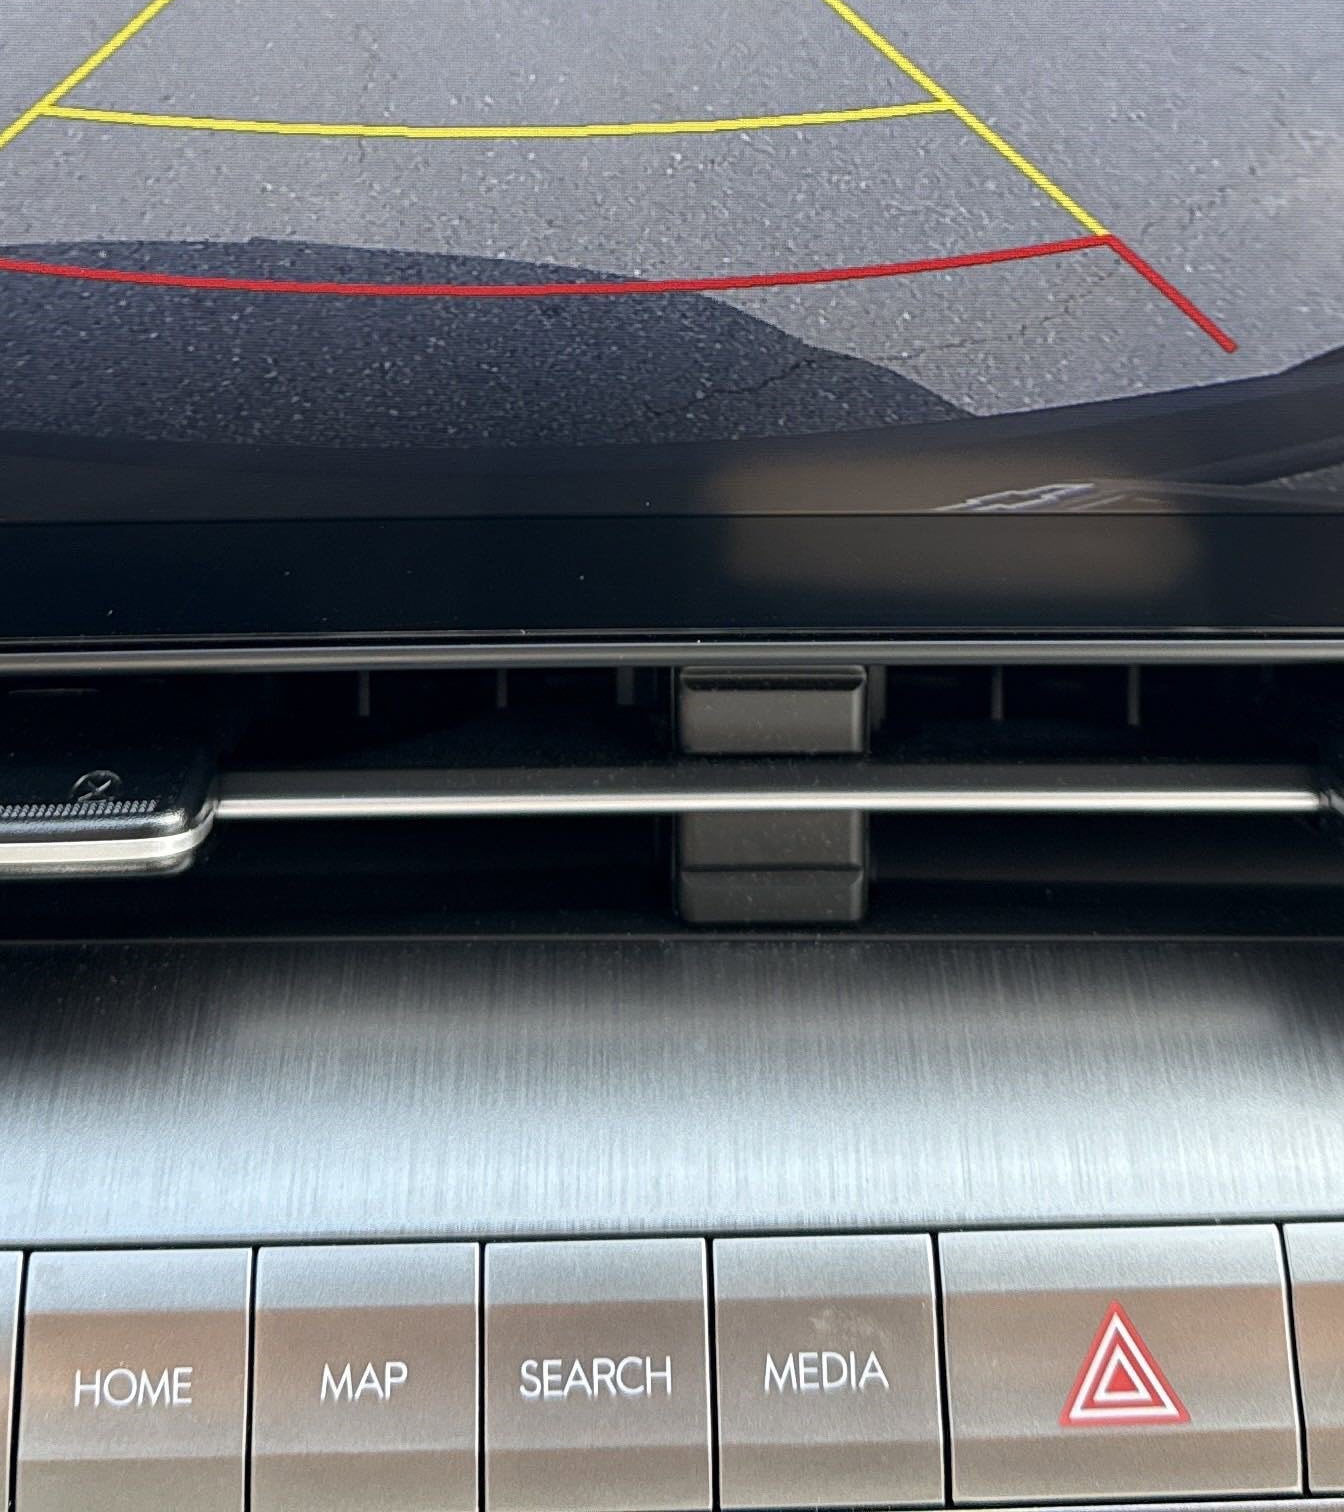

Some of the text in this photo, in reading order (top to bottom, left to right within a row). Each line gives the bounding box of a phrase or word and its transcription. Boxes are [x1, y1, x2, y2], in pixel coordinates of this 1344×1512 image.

[73, 1367, 194, 1408] HOME
[319, 1361, 408, 1402] MAP
[518, 1356, 672, 1398] SEARCH
[763, 1350, 890, 1393] MEDIA
